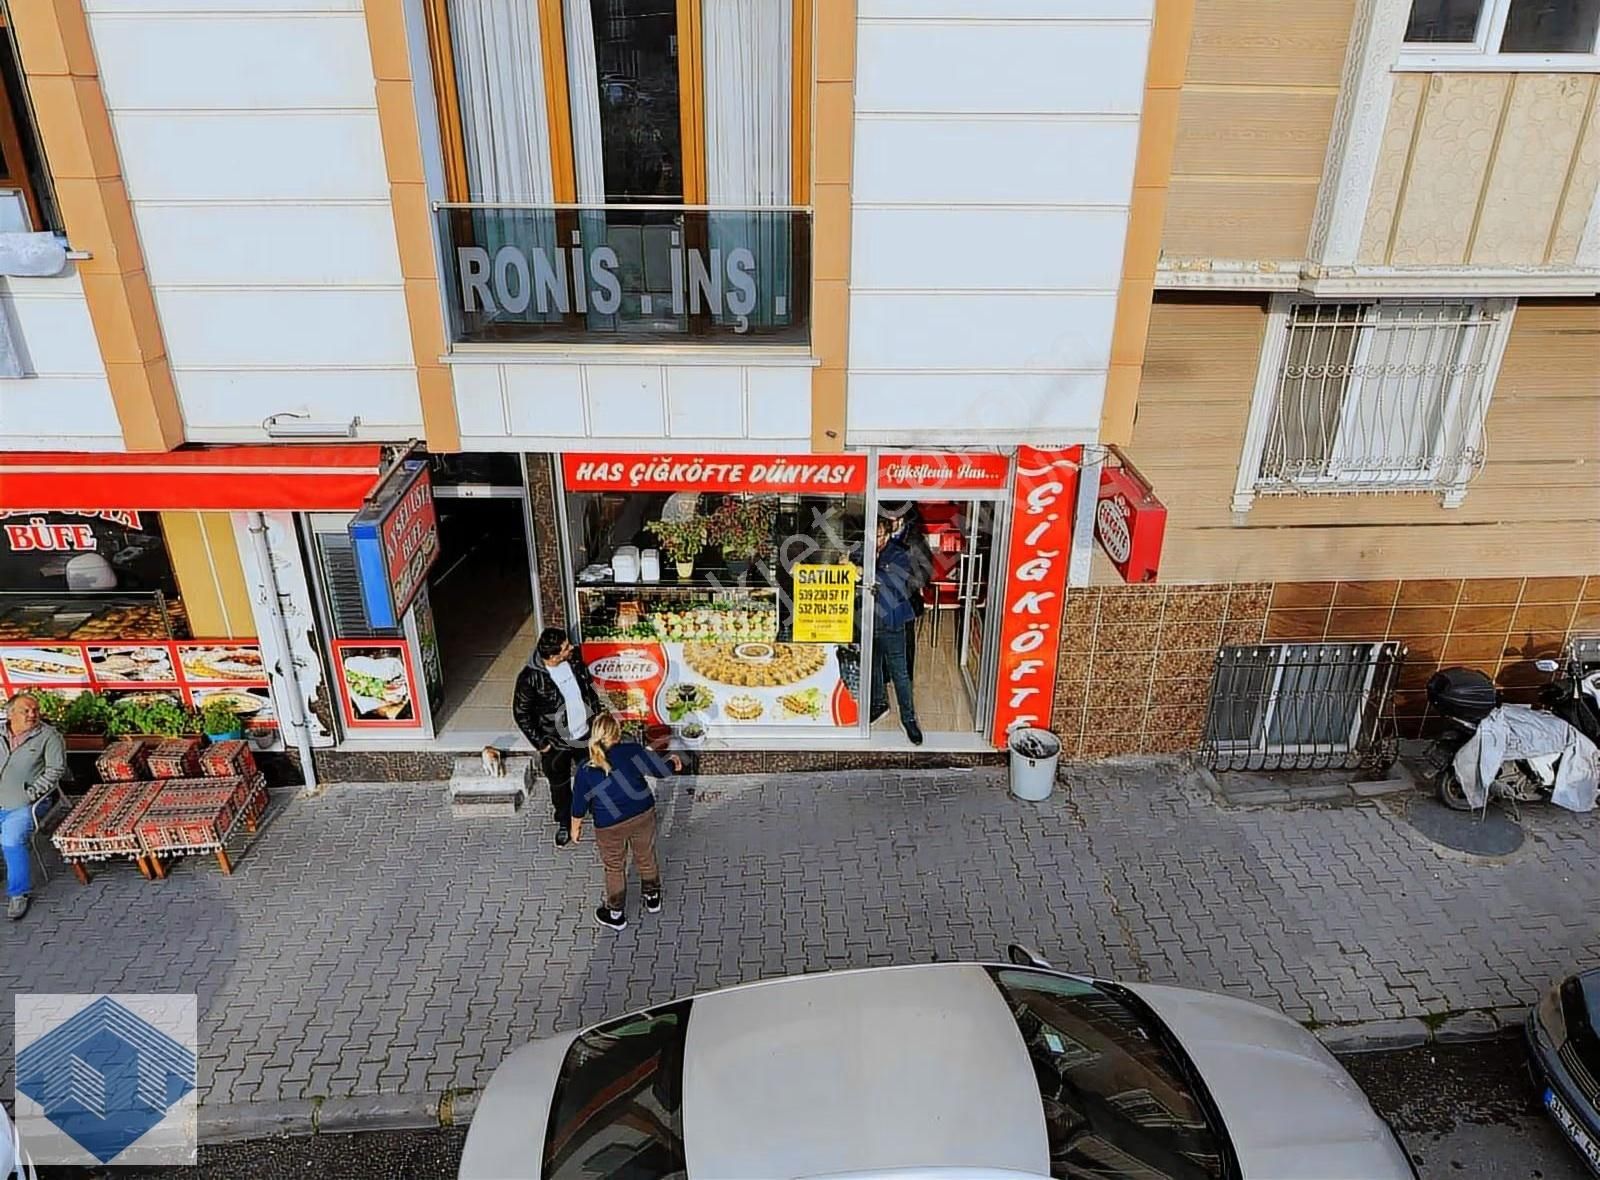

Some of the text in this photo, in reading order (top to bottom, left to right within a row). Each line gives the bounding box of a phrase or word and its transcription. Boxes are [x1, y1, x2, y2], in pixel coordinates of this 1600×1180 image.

[576, 456, 857, 487] HAS ÇİĞKÖFTE DÜNYASI
[4, 516, 97, 551] BÜFE
[798, 569, 850, 585] SATILIK
